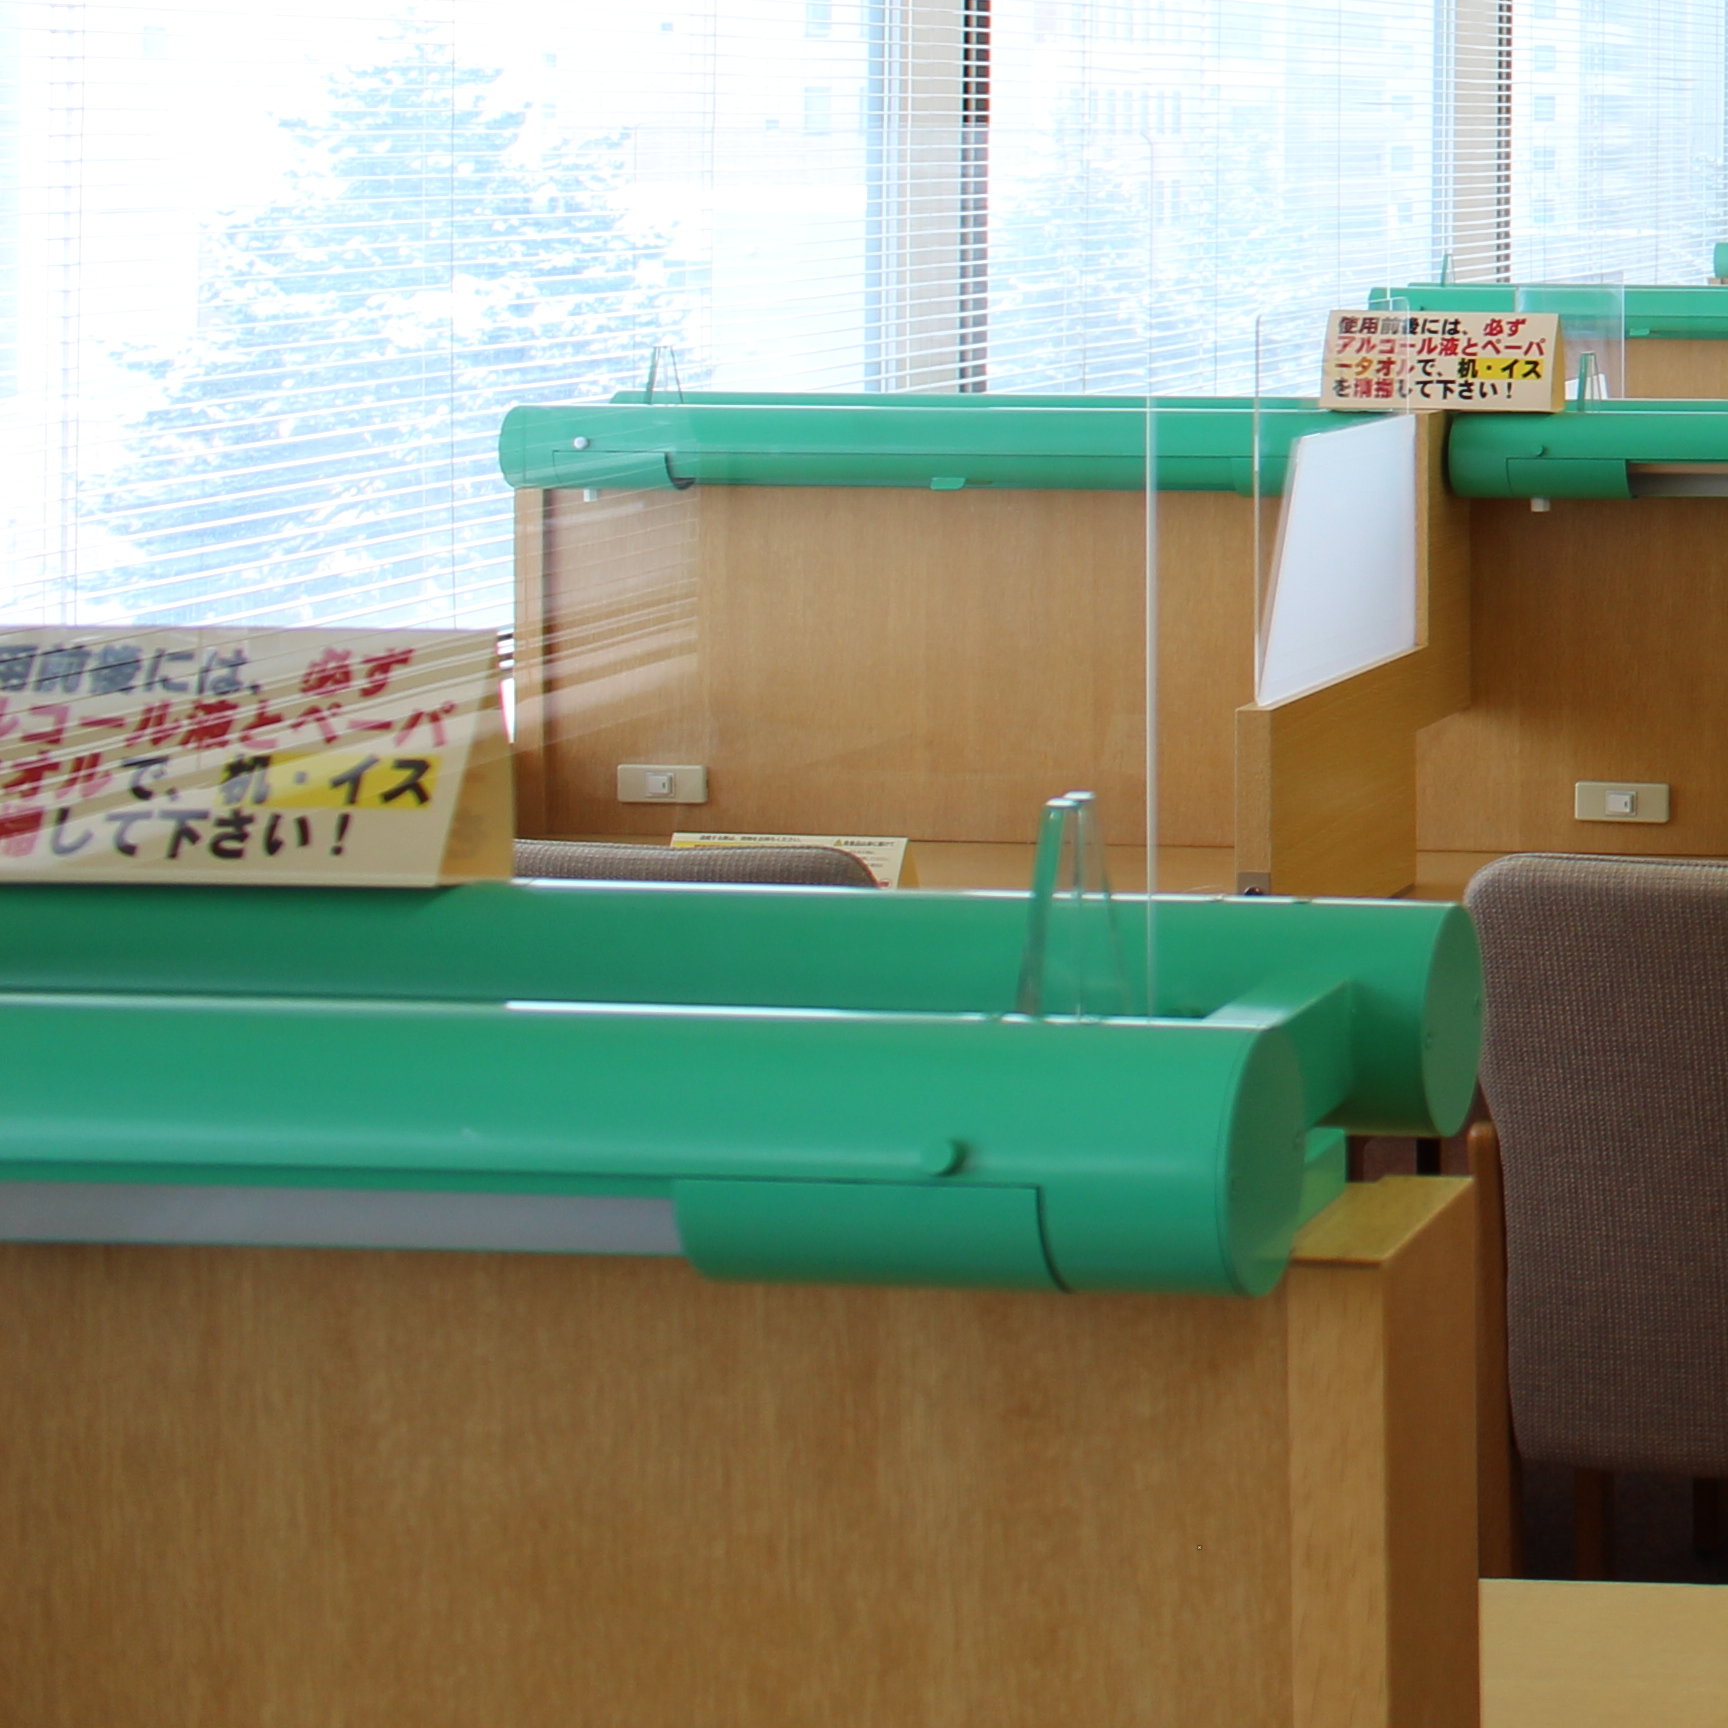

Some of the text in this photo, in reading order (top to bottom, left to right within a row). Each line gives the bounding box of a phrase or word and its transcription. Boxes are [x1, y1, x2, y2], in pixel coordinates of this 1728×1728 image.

[1483, 318, 1526, 337] 必ず
[1336, 337, 1546, 357] アルコール液とペーパ
[1458, 358, 1543, 379] 机・イス
[302, 646, 414, 697] 必ず
[219, 754, 432, 806] 机・イス
